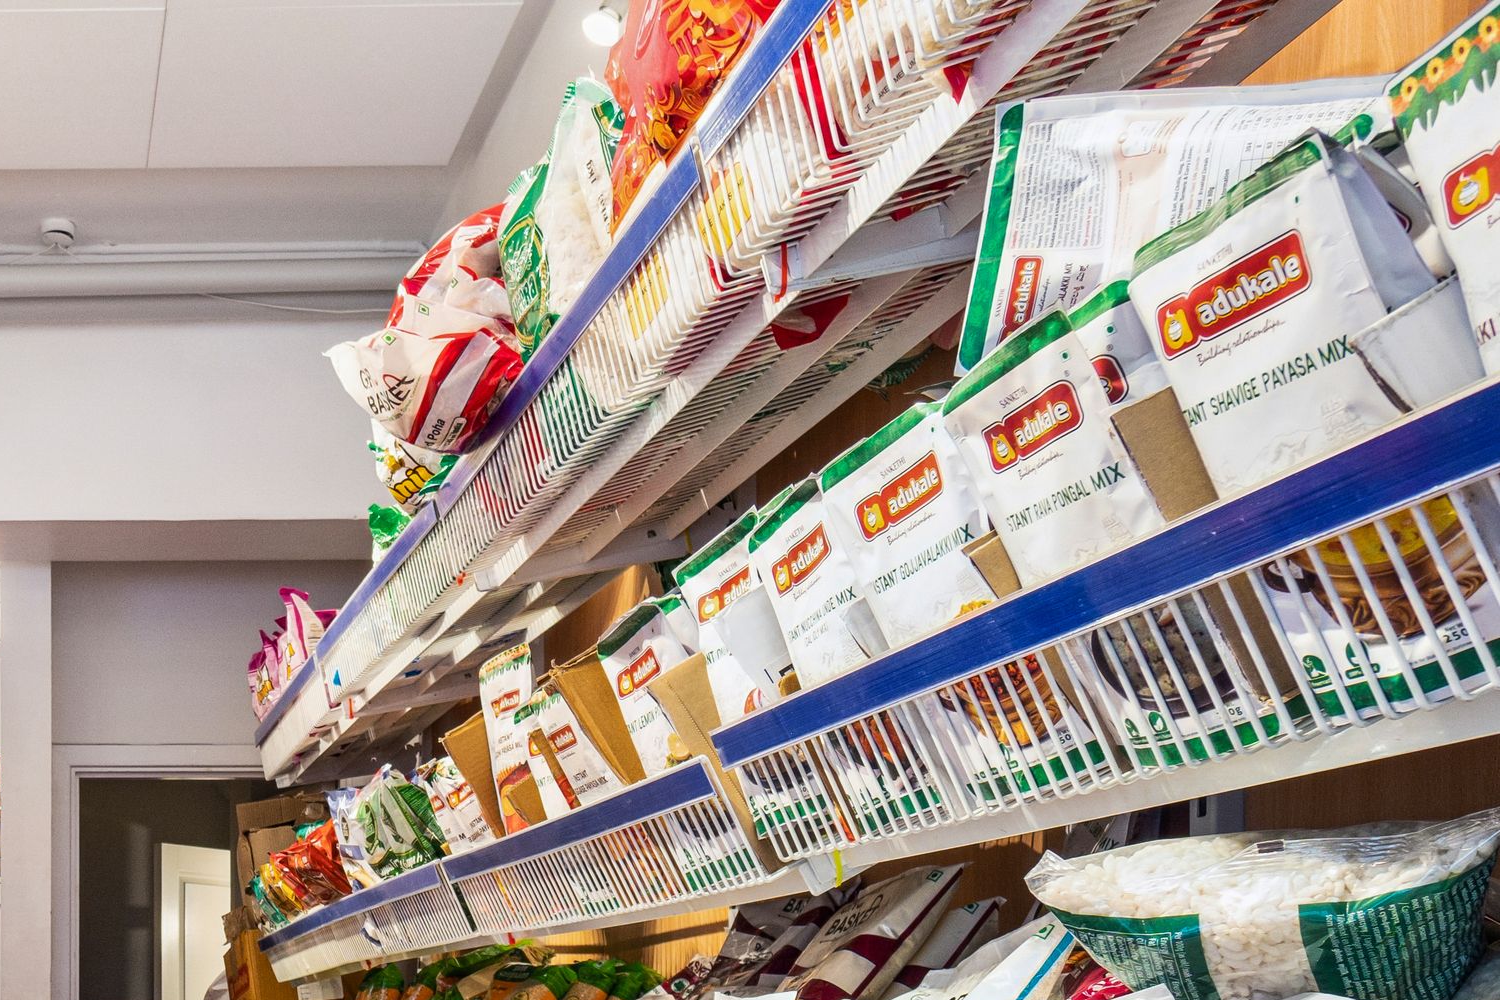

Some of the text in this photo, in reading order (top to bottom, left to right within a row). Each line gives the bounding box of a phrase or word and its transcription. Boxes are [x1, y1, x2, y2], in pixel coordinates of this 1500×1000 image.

[1197, 253, 1302, 327] adukale
[1210, 335, 1353, 417] SHAVIGE PAYASA MIX
[1013, 400, 1071, 450] adukale
[887, 465, 938, 516] adukale
[1053, 480, 1091, 514] PONGAL
[1092, 463, 1125, 491] MIX
[835, 586, 857, 606] MIX
